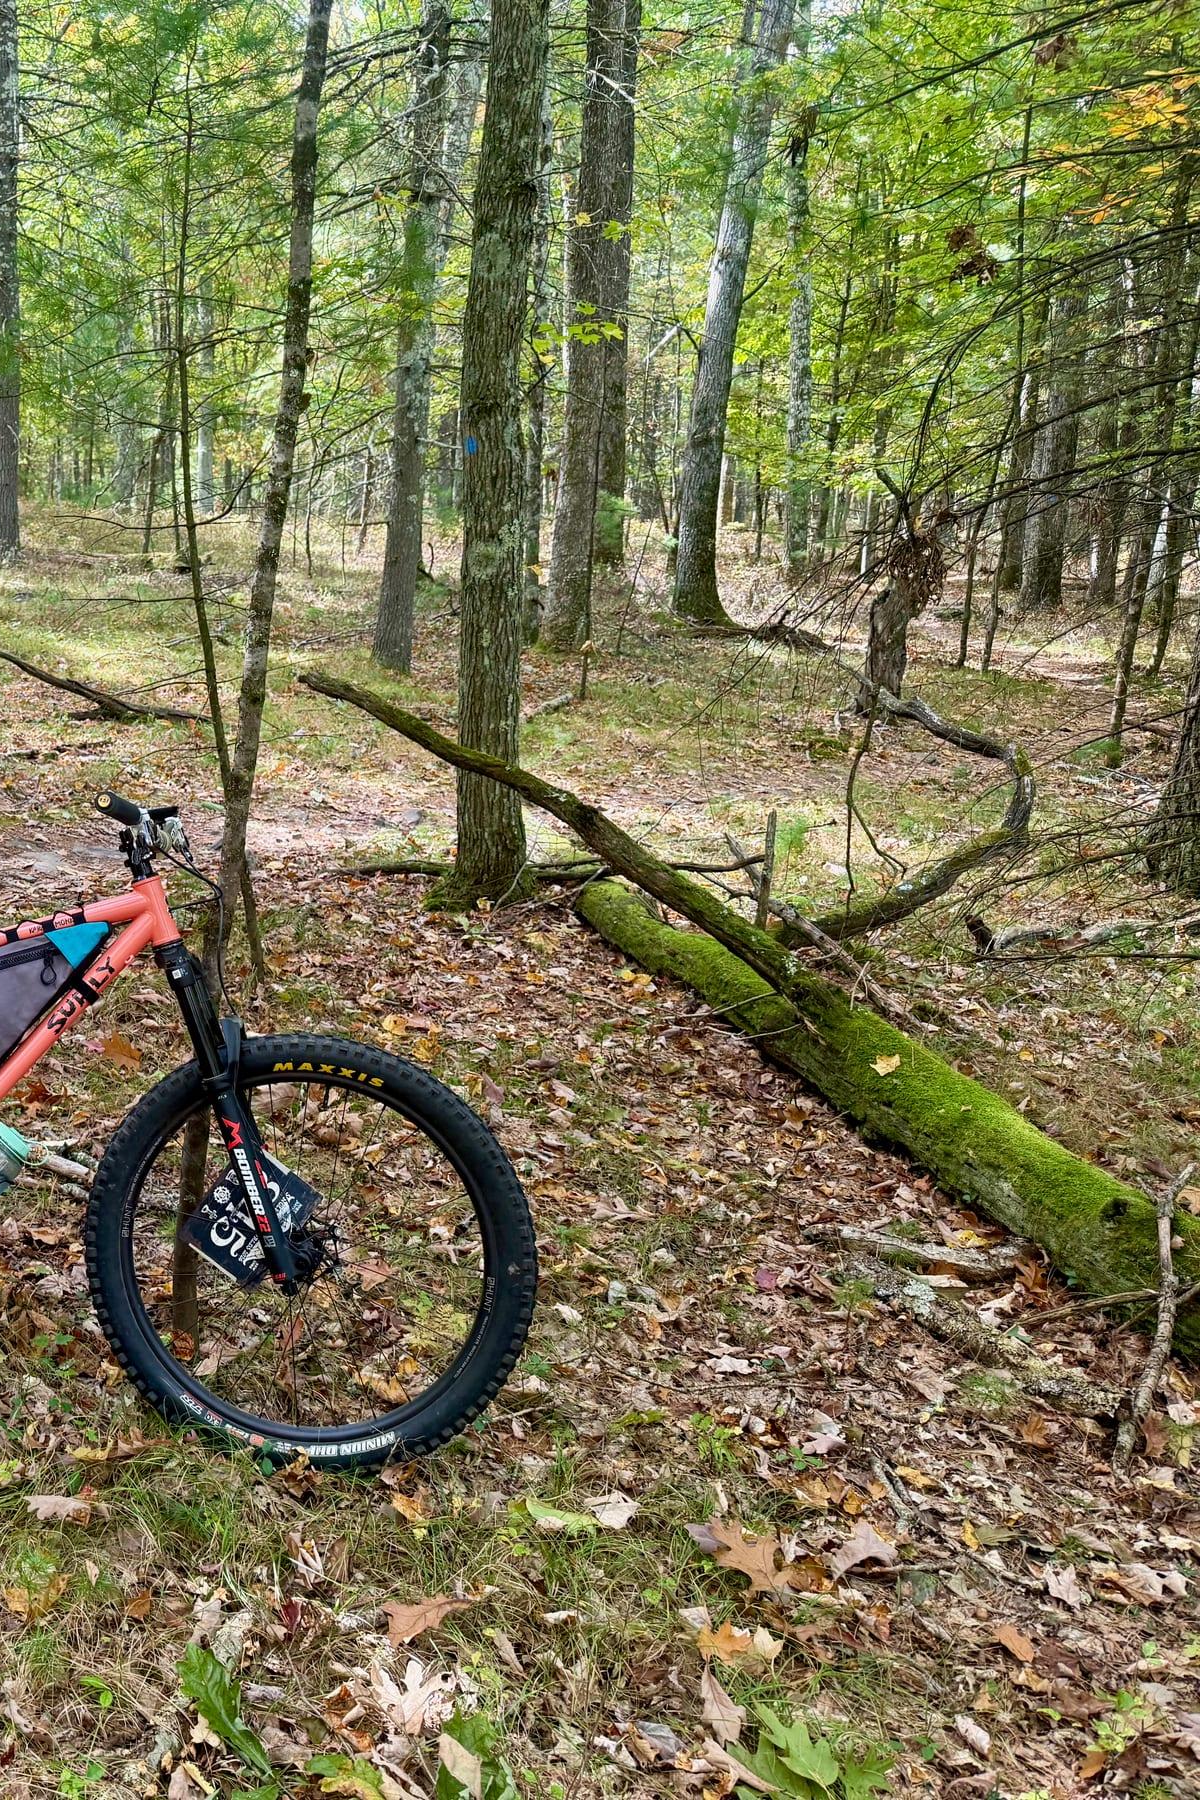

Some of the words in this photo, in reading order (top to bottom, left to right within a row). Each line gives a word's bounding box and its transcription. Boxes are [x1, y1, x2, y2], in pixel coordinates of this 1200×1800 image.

[272, 1061, 385, 1088] MAXXIS
[233, 1148, 266, 1216] BOMBER
[122, 1202, 133, 1230] HUNT
[483, 1284, 495, 1314] HUNT
[339, 1431, 397, 1456] MINION
